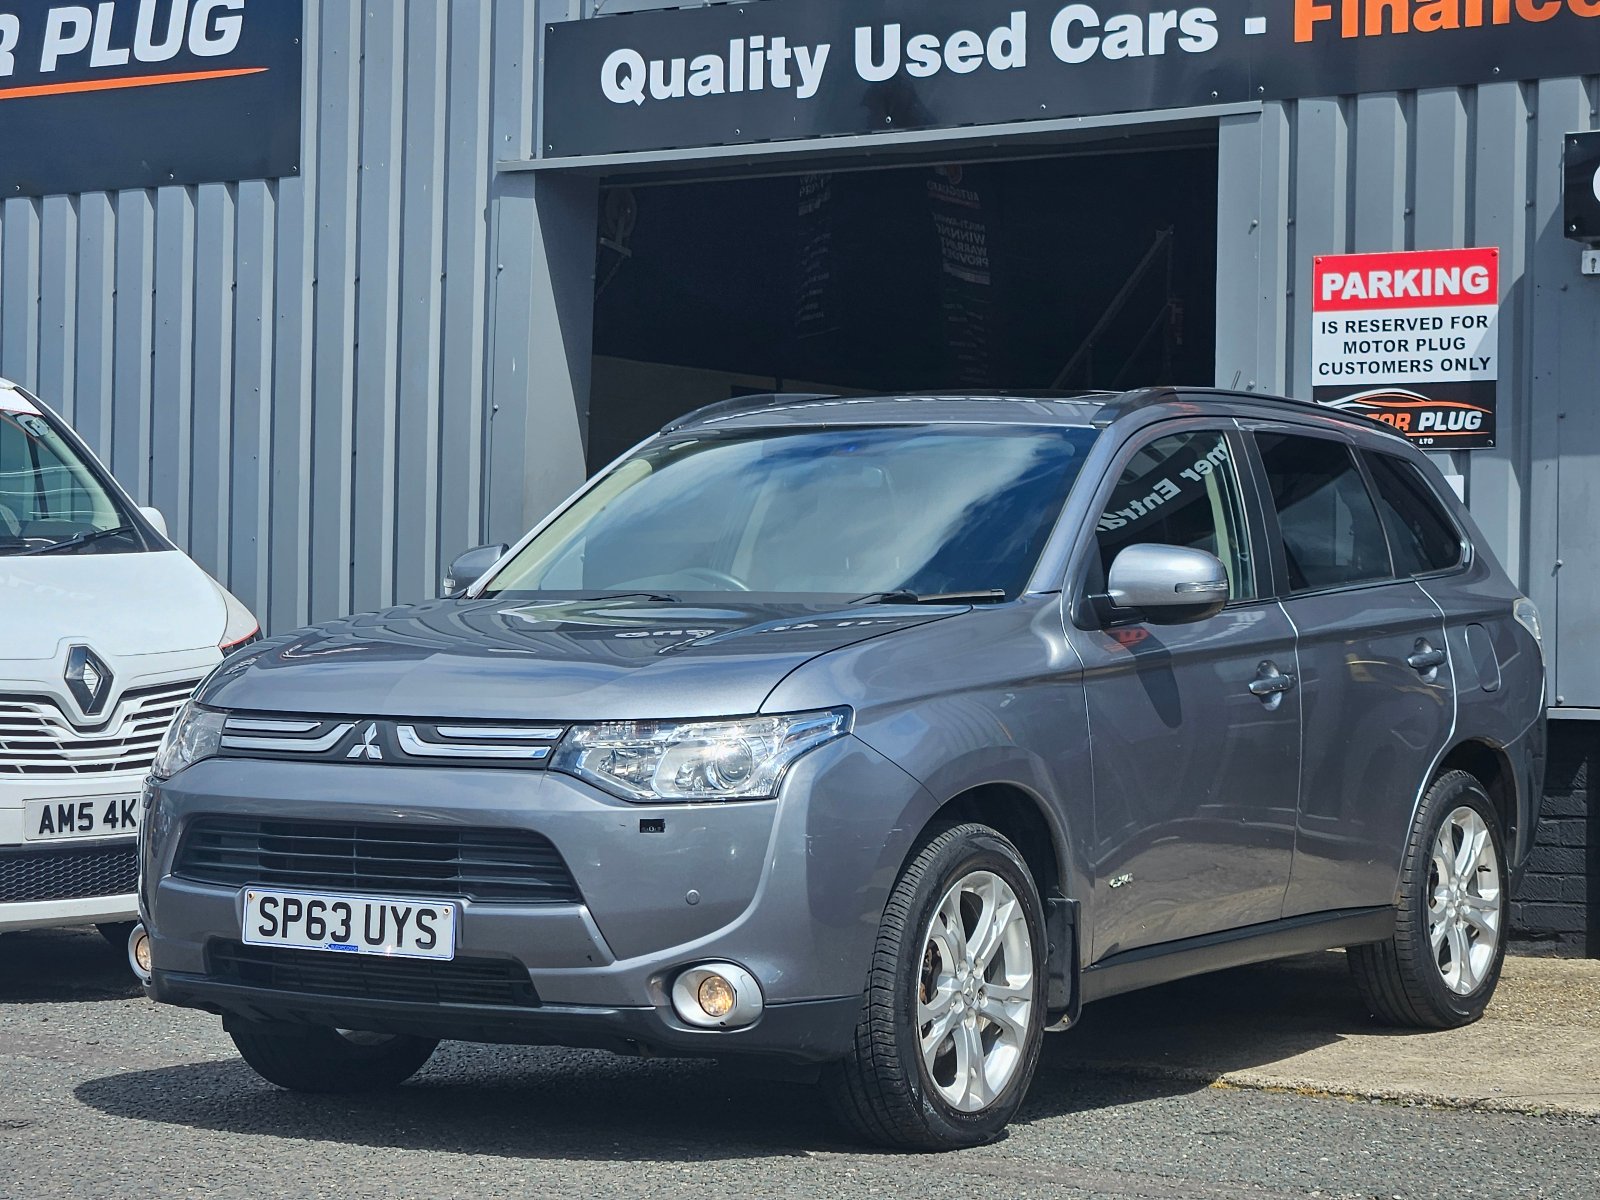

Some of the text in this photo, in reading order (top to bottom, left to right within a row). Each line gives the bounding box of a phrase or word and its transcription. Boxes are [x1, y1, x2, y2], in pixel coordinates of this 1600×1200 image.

[40, 0, 245, 73] PLUG
[601, 35, 830, 106] Quality
[854, 12, 1027, 83] Used
[1050, 4, 1218, 65] Cars
[1322, 266, 1489, 301] PARKING
[1321, 315, 1488, 334] IS RESERVED FOR
[1343, 337, 1466, 354] MOTOR PLUG
[1319, 357, 1491, 375] CUSTOMERS ONLY
[1418, 411, 1483, 431] PLUG
[39, 798, 140, 834] AM5 4K
[258, 896, 438, 949] SP63 UYS
